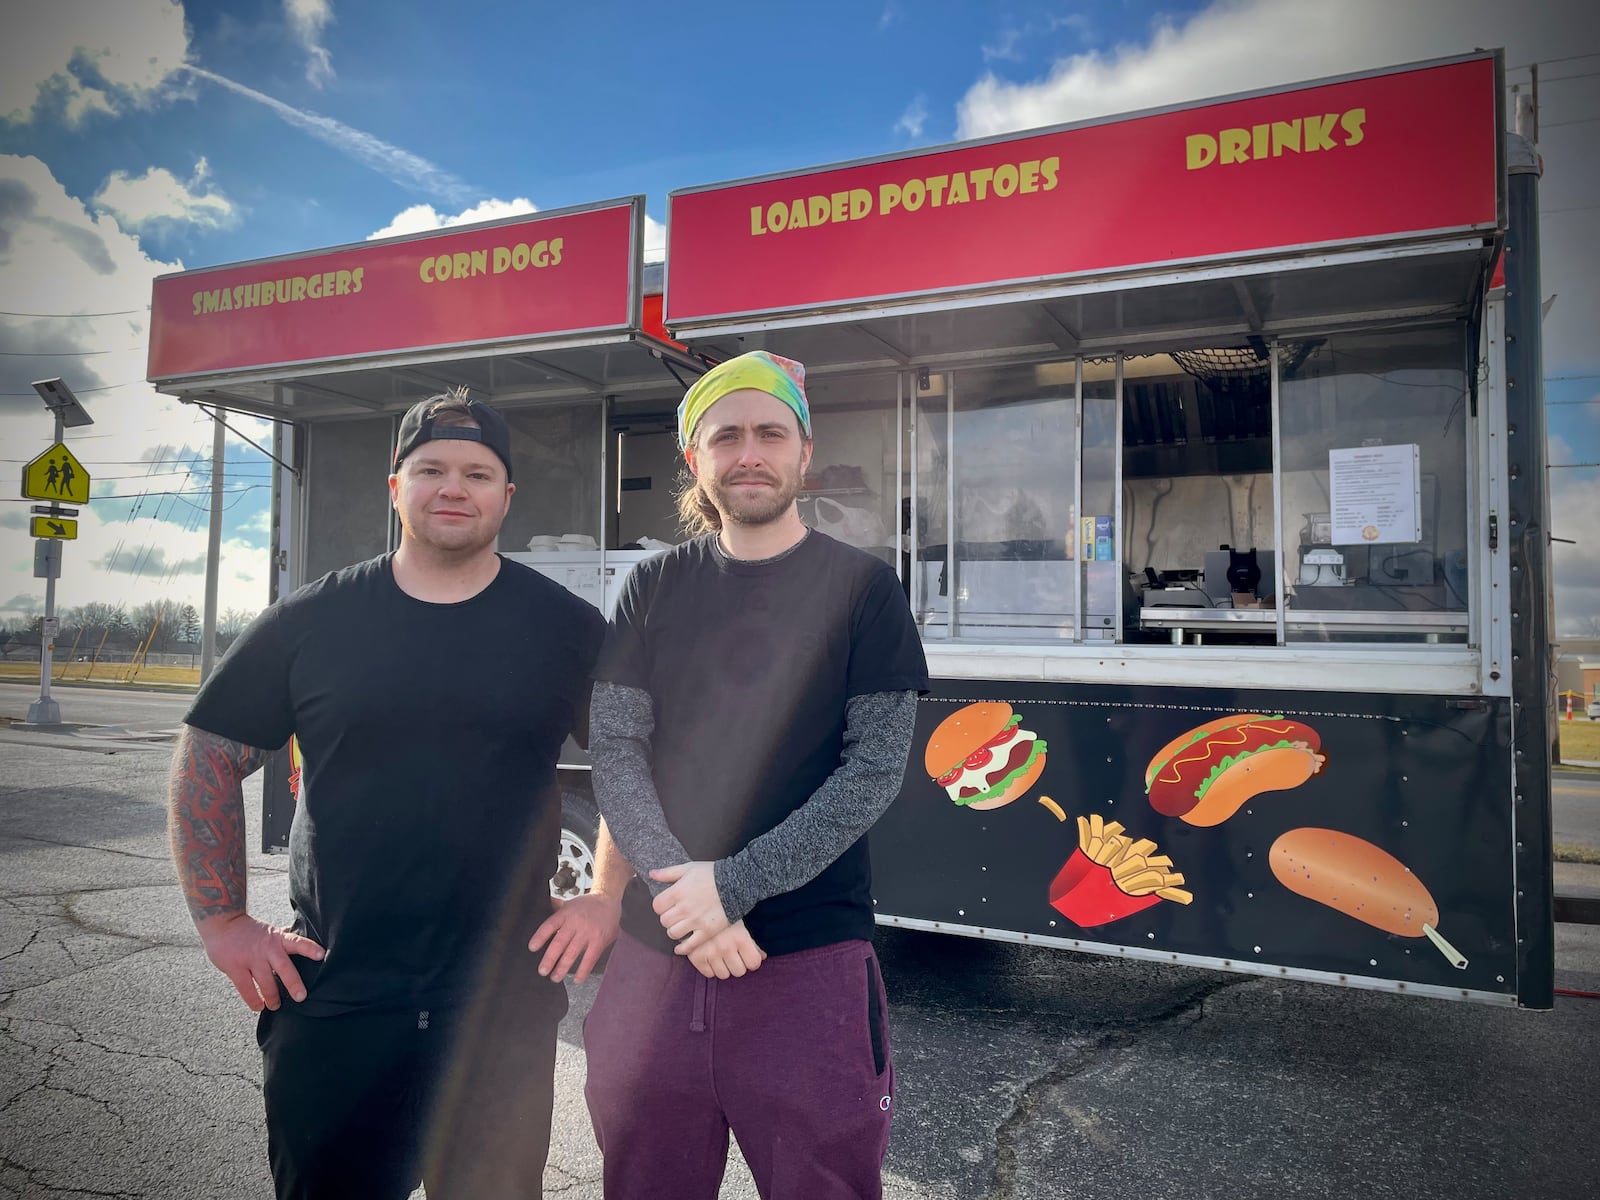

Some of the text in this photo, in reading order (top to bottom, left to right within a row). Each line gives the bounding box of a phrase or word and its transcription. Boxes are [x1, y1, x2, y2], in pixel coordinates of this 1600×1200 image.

[1186, 108, 1366, 171] DRINKS
[750, 156, 1061, 237] LOADED POTATOES
[419, 237, 564, 285] CORN DOGS
[192, 268, 364, 316] SMASHBURGERS
